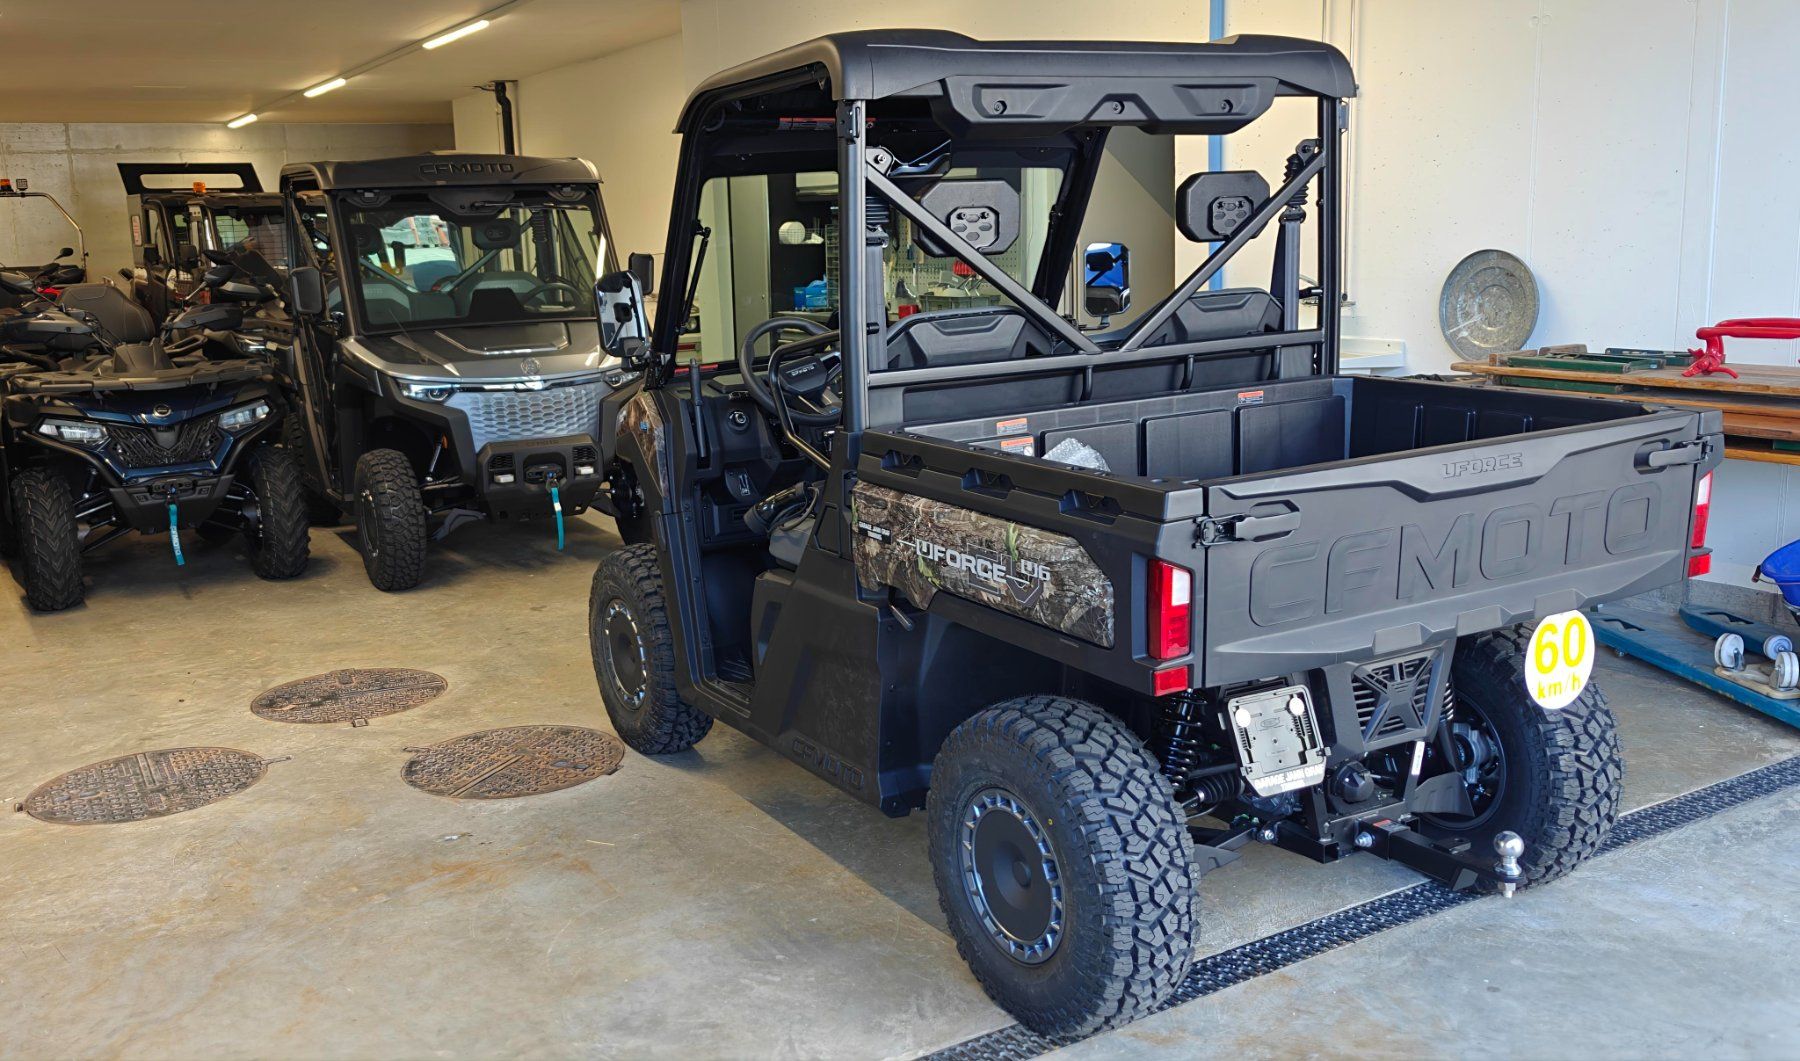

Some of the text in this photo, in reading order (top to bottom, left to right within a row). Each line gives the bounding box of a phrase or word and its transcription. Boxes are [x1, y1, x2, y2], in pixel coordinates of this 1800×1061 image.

[419, 161, 514, 176] CFMOTO
[1443, 451, 1523, 479] UFORCE
[915, 538, 1051, 583] UFORCE U6
[1248, 480, 1662, 628] CFMOTO
[1535, 617, 1586, 675] 60
[1537, 672, 1581, 699] km/h
